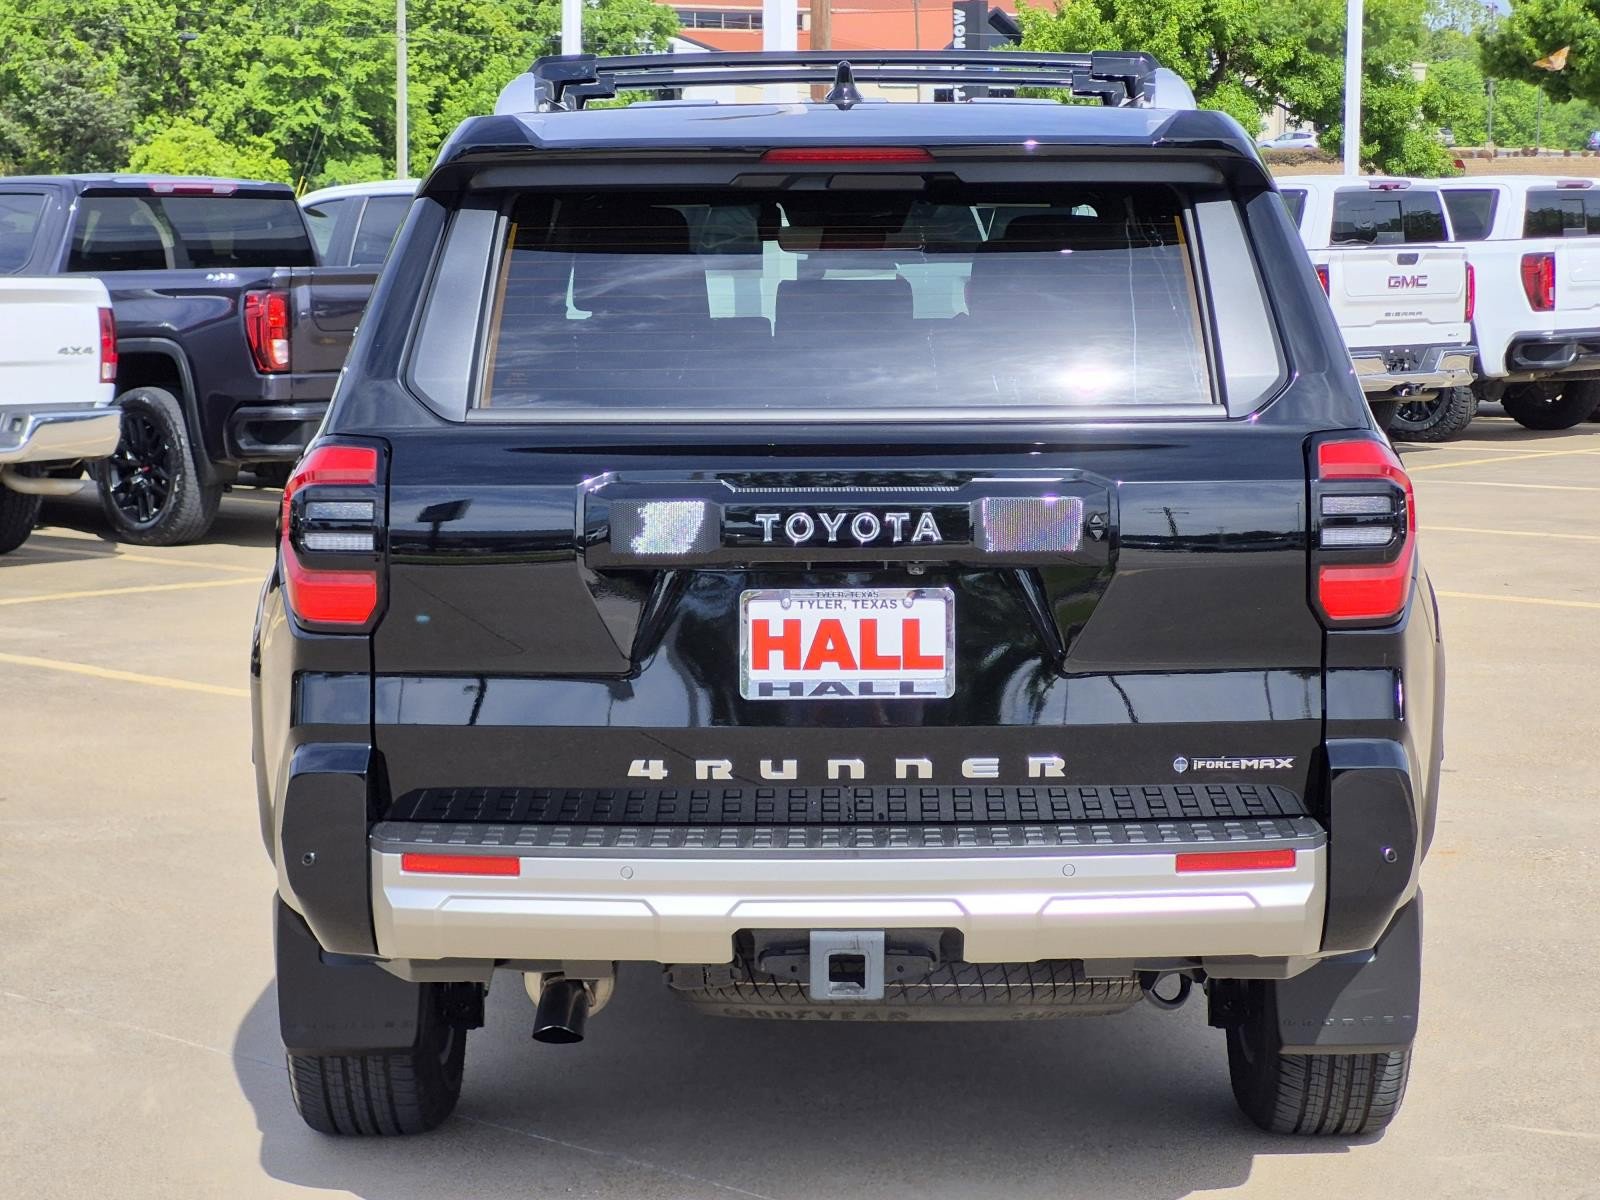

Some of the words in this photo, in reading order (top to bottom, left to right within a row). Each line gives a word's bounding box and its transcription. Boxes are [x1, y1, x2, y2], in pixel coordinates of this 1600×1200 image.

[1388, 275, 1428, 288] GMC
[755, 511, 943, 543] TOYOTA
[798, 600, 847, 611] TYLER,
[852, 600, 898, 610] TEXAS
[751, 618, 944, 670] HALL
[758, 681, 937, 697] HALL
